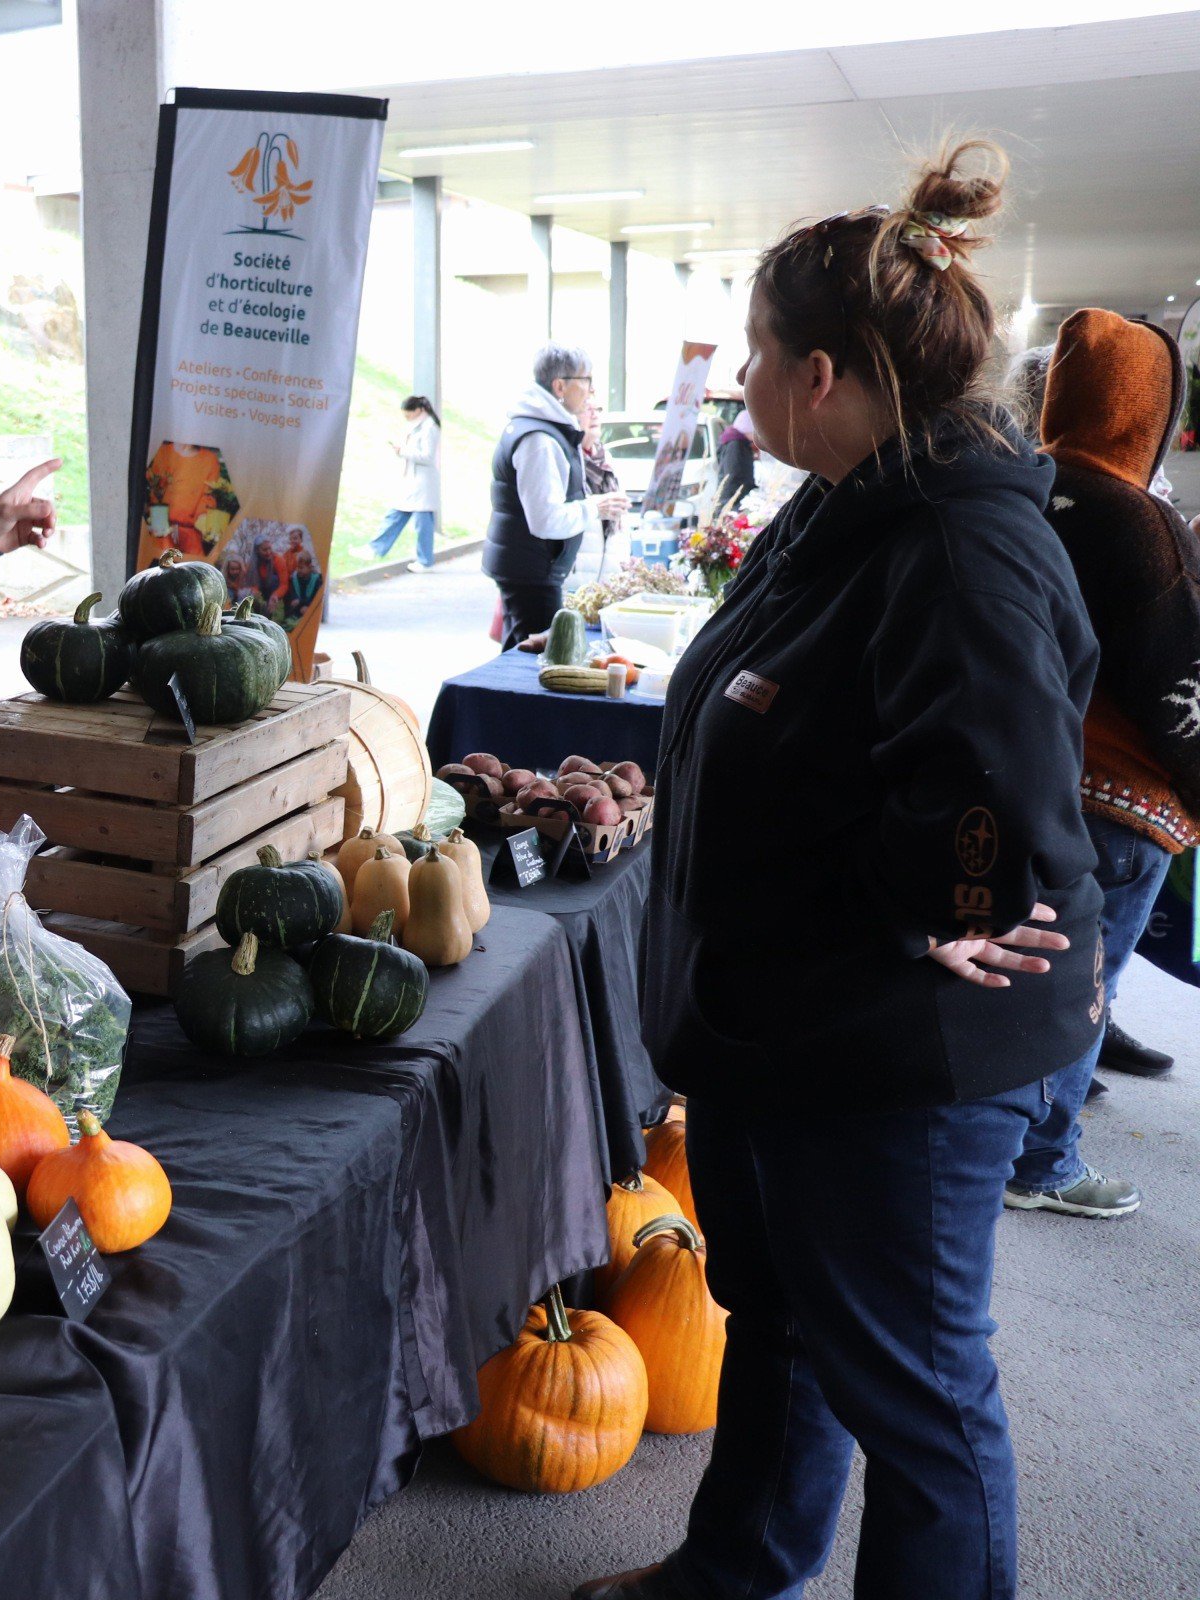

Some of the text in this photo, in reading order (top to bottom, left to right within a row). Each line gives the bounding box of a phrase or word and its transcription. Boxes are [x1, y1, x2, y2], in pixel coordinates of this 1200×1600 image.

[233, 252, 291, 270] Société
[206, 273, 313, 297] d'horticulture
[209, 299, 306, 322] et d'écologie
[200, 319, 310, 345] de Beauceville
[177, 360, 232, 378] Ateliers
[170, 378, 328, 410] Projets spéciaux Social
[194, 401, 301, 429] Visites Voyages
